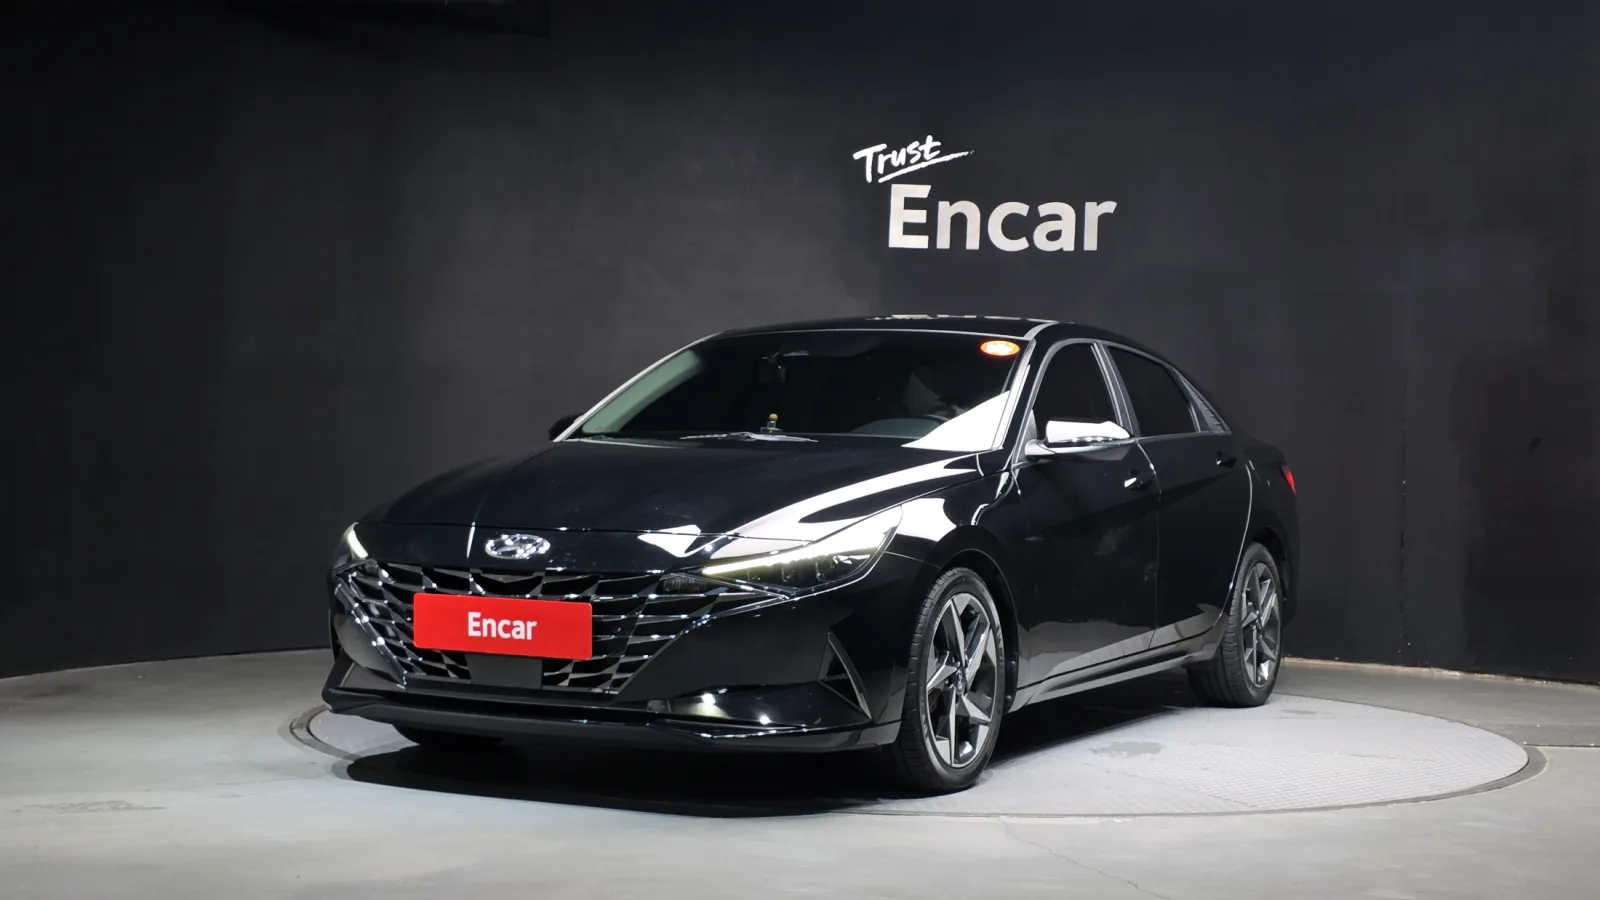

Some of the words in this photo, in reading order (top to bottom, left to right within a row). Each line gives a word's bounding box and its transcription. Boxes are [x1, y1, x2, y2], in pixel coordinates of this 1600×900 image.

[853, 135, 942, 183] Trust
[888, 183, 1117, 251] Encar
[467, 611, 537, 640] Encar
